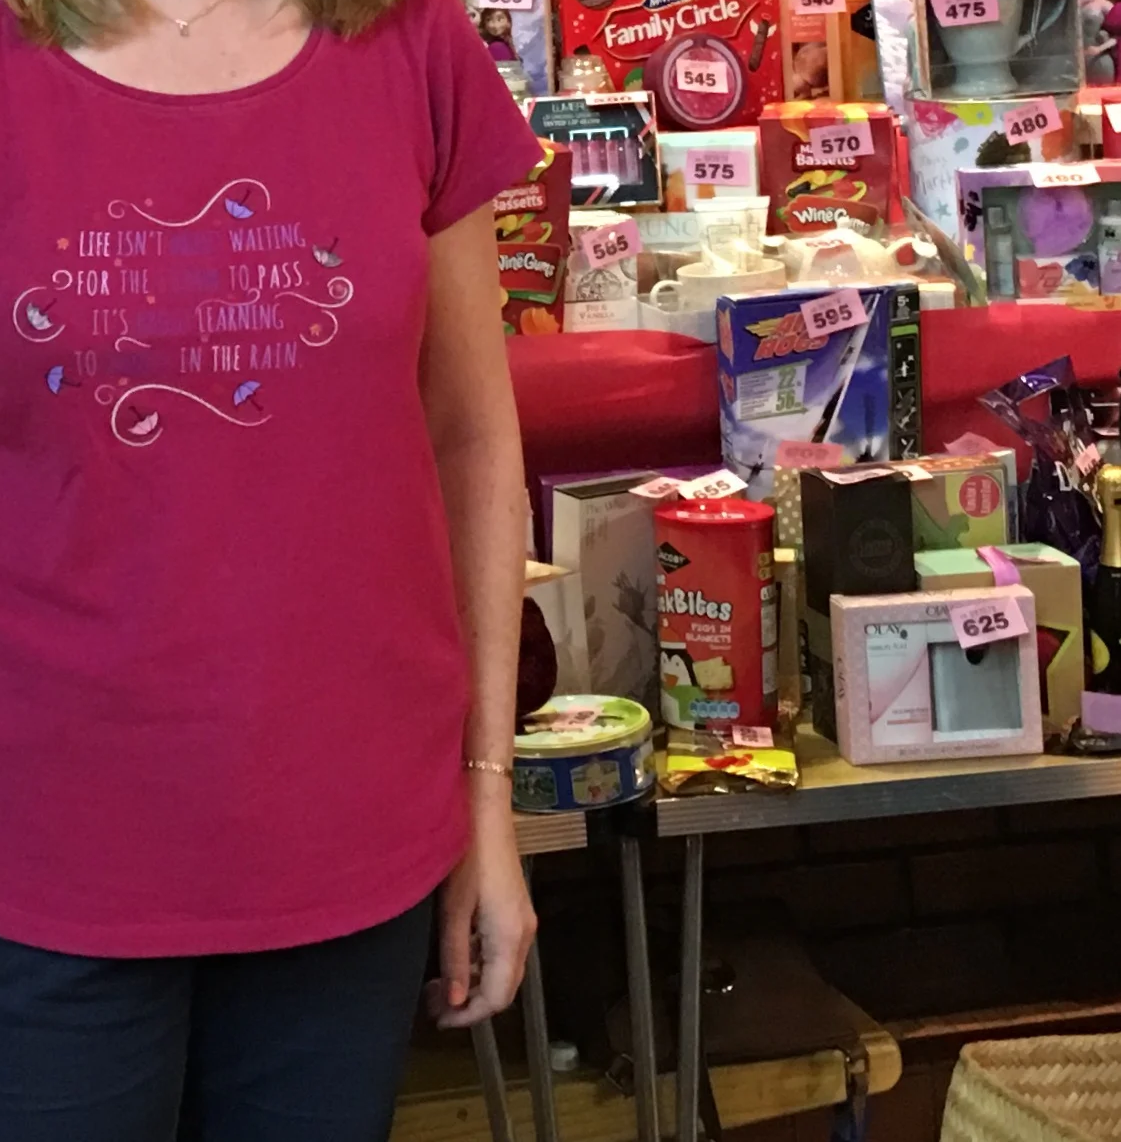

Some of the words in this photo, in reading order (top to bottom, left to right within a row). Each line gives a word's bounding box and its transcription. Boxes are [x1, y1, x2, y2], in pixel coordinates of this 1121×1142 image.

[944, 0, 987, 20] 475
[604, 13, 675, 49] Family
[683, 71, 717, 88] 545
[1009, 113, 1049, 138] 480
[820, 136, 860, 154] 570
[694, 163, 735, 179] 575
[79, 231, 111, 258] LIFE
[116, 229, 164, 257] ISN'T
[228, 221, 307, 252] WAITING
[593, 235, 629, 260] 585
[76, 269, 110, 296] FOR
[119, 269, 150, 294] THE
[228, 264, 250, 291] TO
[91, 308, 129, 336] IT'S
[196, 302, 285, 334] LEARNING
[813, 304, 853, 330] 595
[75, 350, 98, 376] TO
[179, 345, 202, 373] IN
[211, 344, 241, 372] THE
[692, 479, 732, 500] 655
[864, 622, 901, 636] OLAY
[962, 611, 1010, 638] 625
